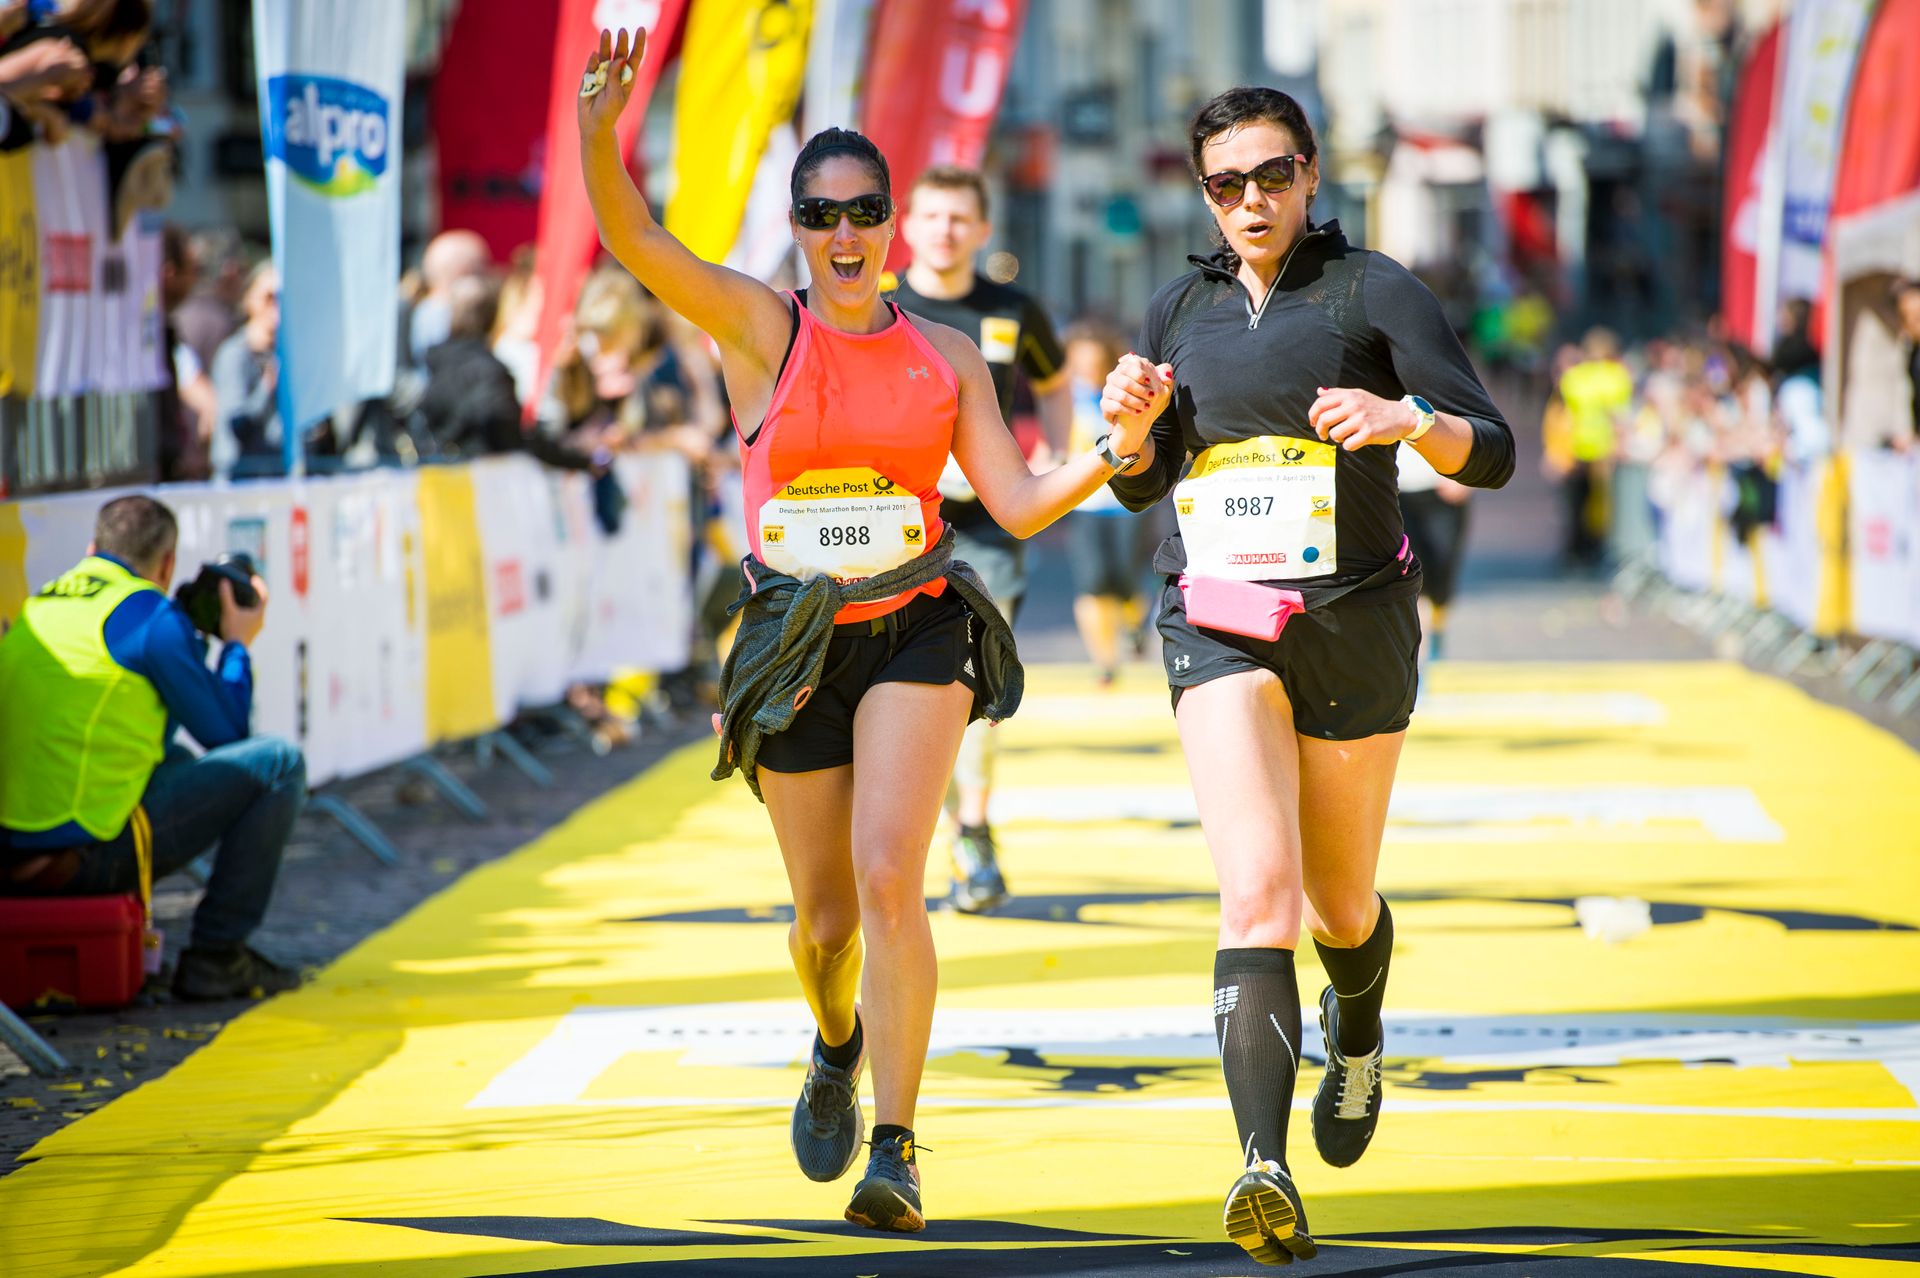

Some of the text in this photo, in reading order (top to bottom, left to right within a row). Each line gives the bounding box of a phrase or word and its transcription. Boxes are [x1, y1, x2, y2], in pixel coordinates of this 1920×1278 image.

[285, 80, 386, 168] alpro
[1208, 452, 1276, 471] Deutsche Post
[787, 482, 869, 496] Deutsche Post
[779, 507, 805, 515] Deutsche
[806, 506, 818, 514] Post
[819, 505, 850, 513] Marathon
[876, 504, 891, 512] April
[1225, 496, 1274, 517] 8987
[819, 526, 870, 547] 8988
